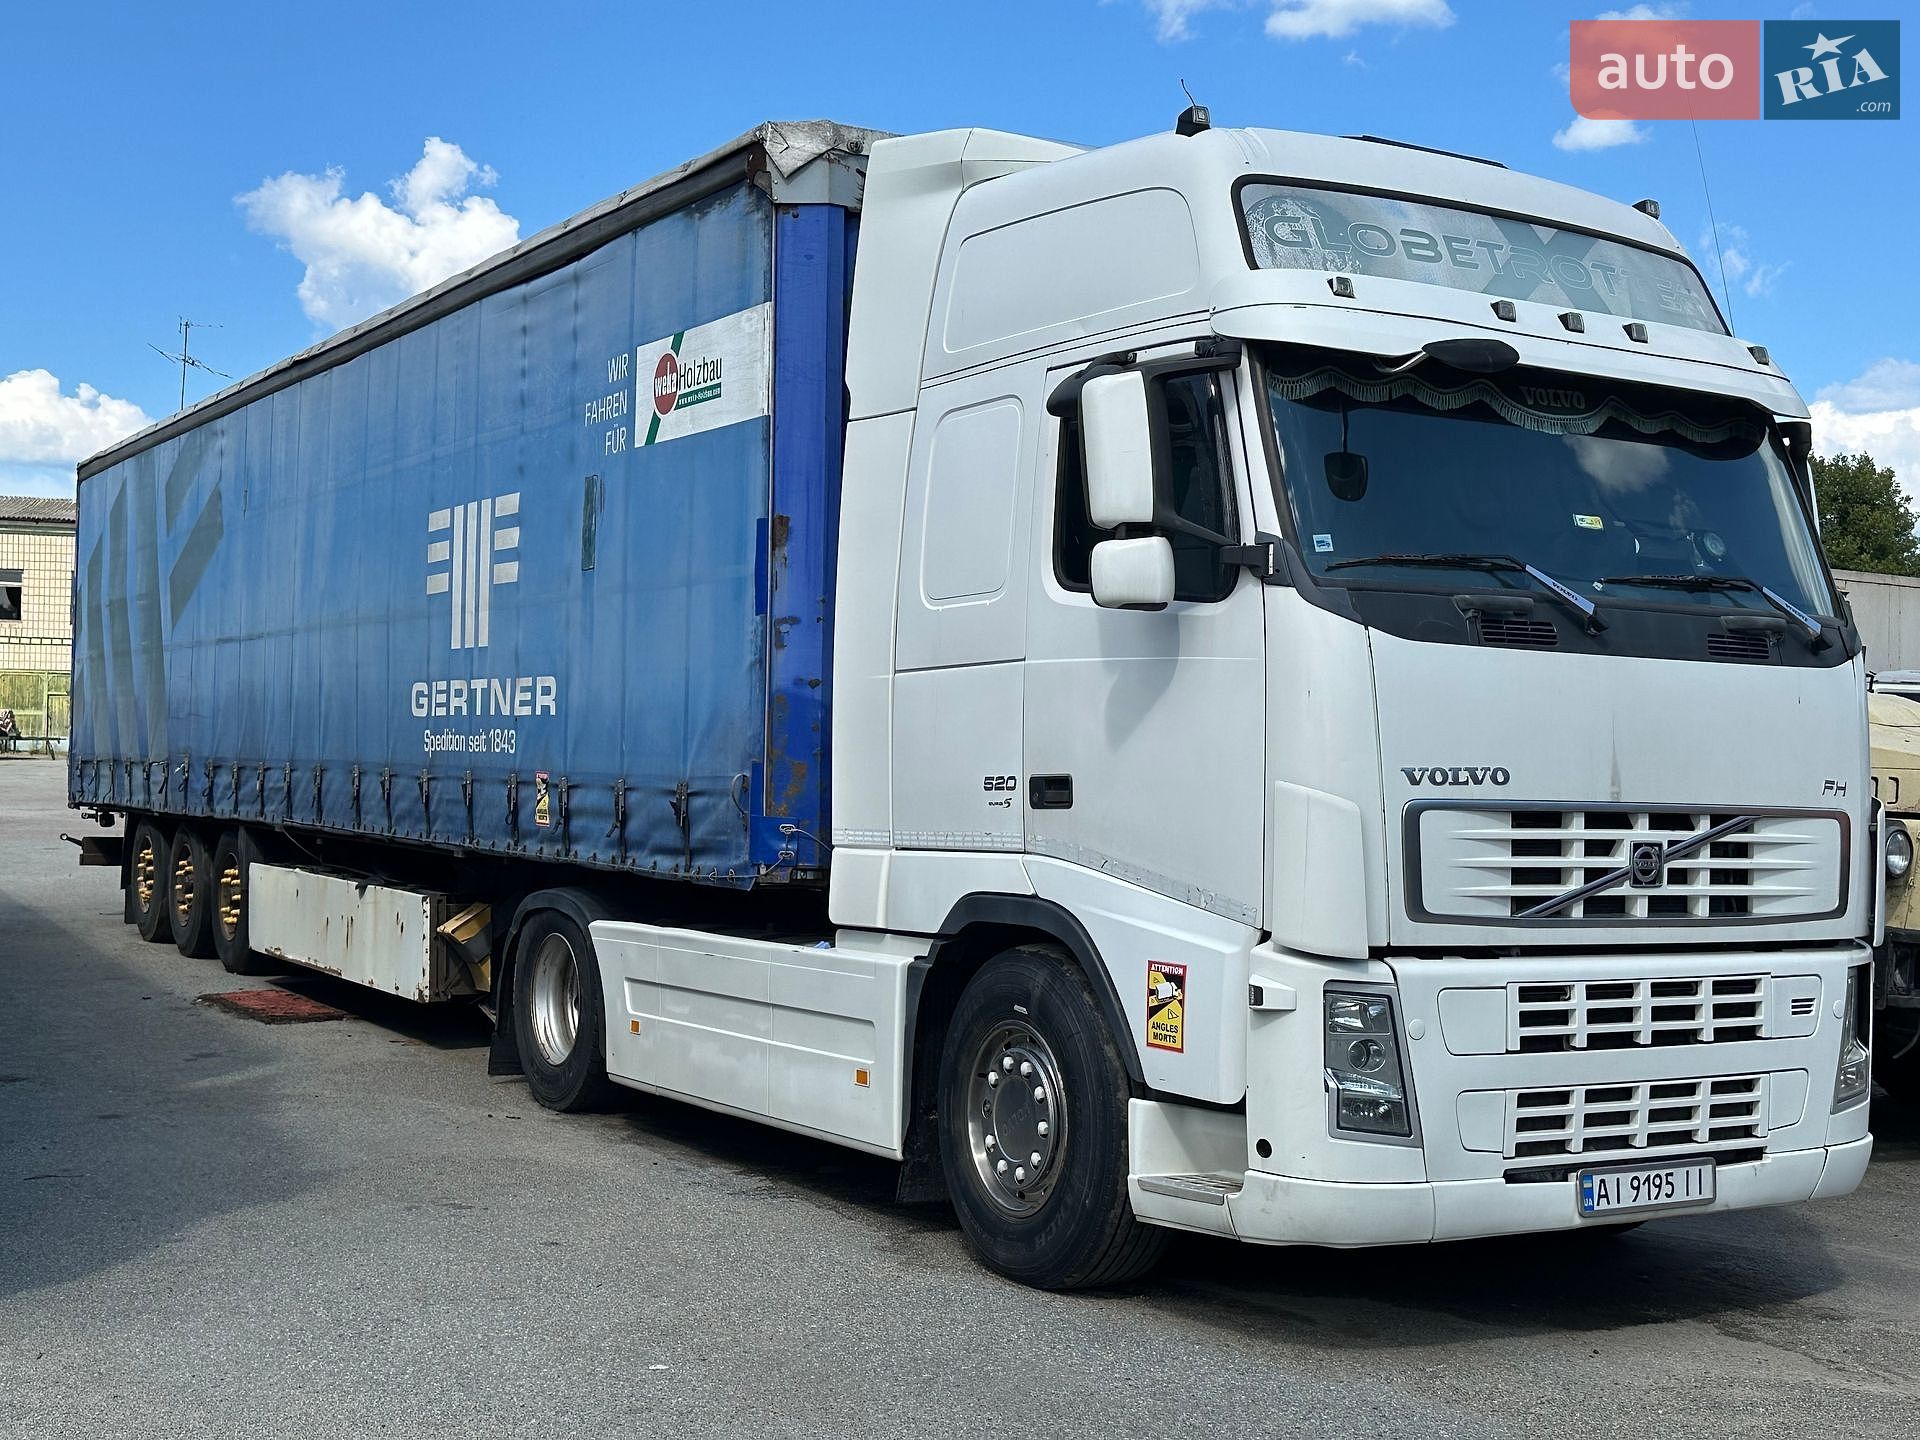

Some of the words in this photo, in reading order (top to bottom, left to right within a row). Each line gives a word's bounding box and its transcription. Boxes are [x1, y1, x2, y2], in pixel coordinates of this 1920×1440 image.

[1263, 214, 1706, 316] GLOBETROTER
[607, 353, 629, 384] WIR
[655, 361, 677, 398] weka
[679, 356, 722, 391] Holzbau
[585, 389, 628, 427] FAHREN
[1519, 386, 1586, 410] VOLVO
[605, 423, 627, 456] FÜR
[411, 676, 557, 717] GERTNER
[424, 728, 466, 758] Spedition
[468, 729, 487, 752] seit
[489, 729, 516, 754] 1843
[983, 775, 1017, 791] 520
[1400, 766, 1510, 786] VOLVO
[1822, 780, 1847, 797] FH
[1151, 963, 1184, 975] ATTENTION
[1151, 1021, 1179, 1034] ANGLES
[1153, 1031, 1177, 1044] MORTS
[1597, 1177, 1620, 1206] AI
[1630, 1172, 1675, 1202] 9195
